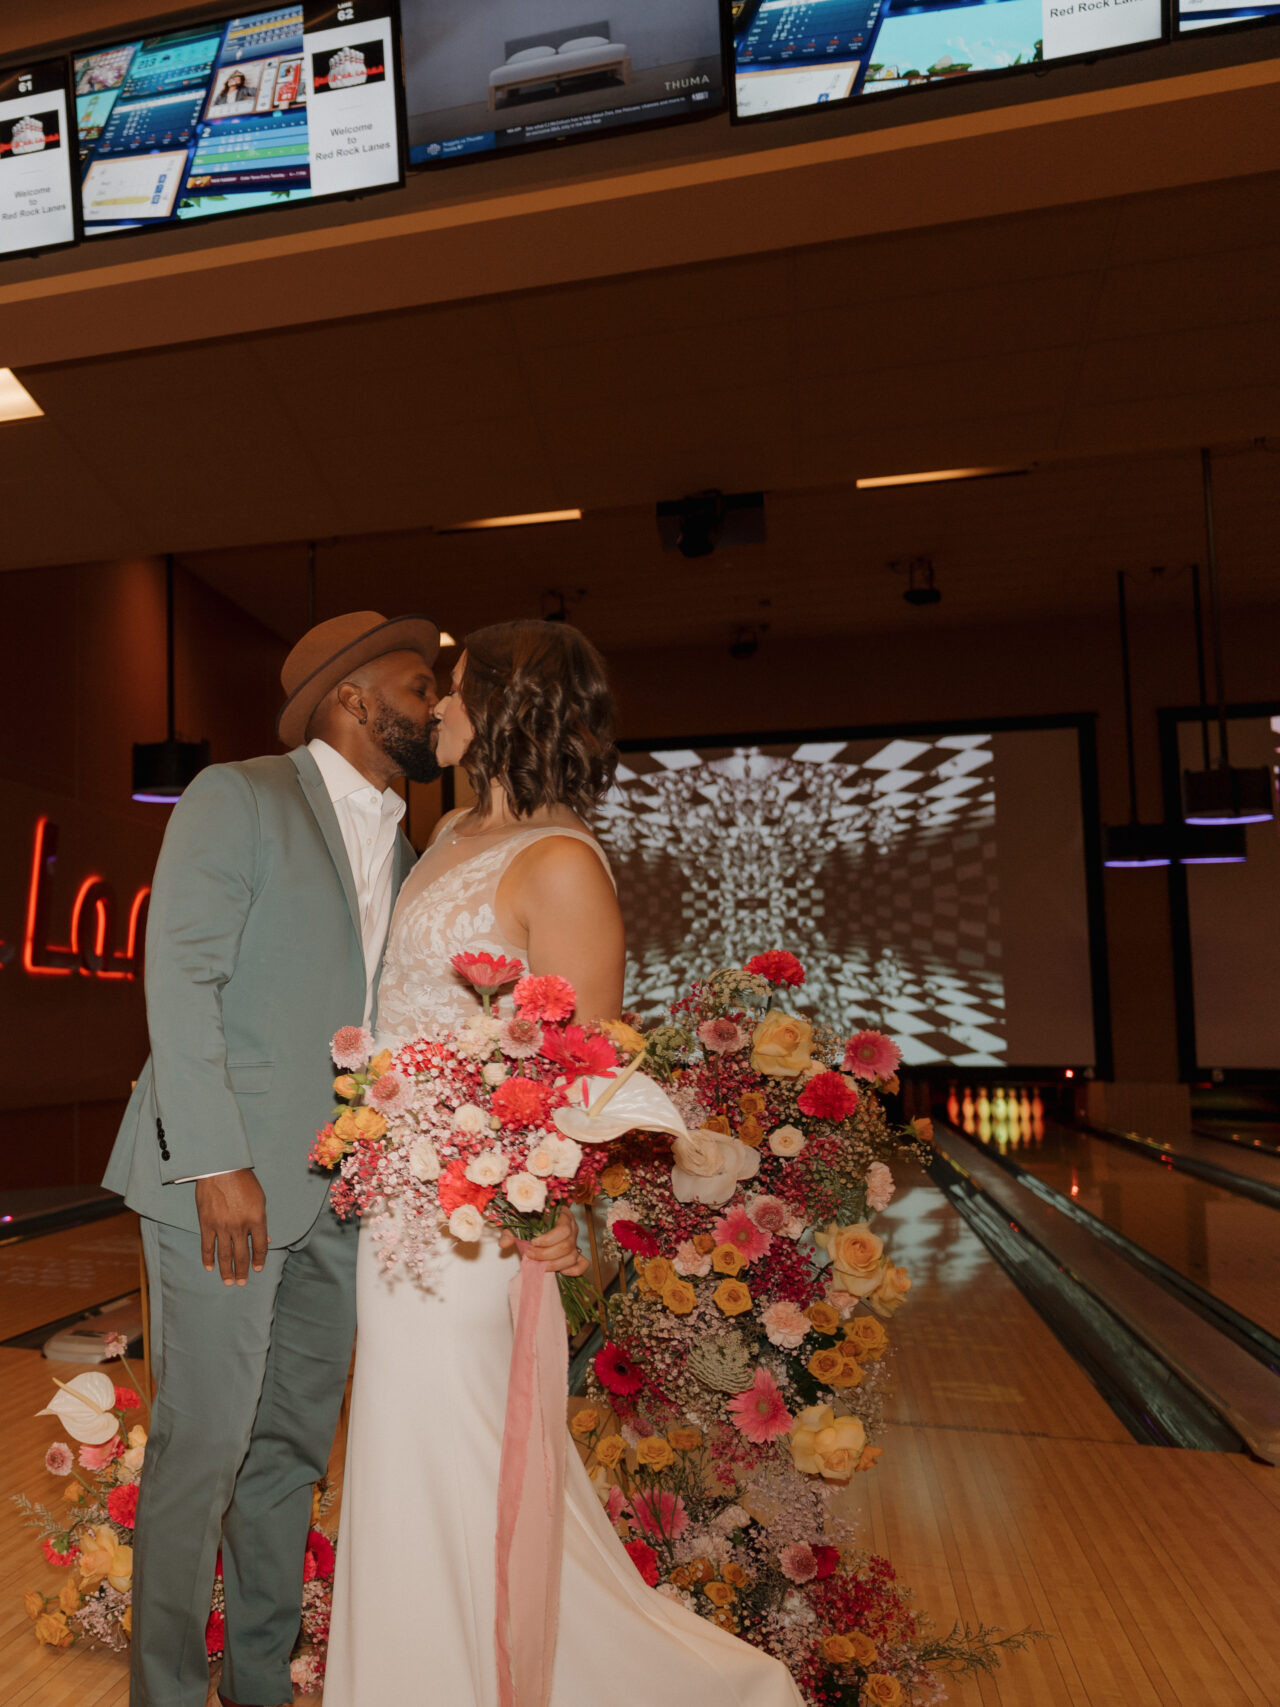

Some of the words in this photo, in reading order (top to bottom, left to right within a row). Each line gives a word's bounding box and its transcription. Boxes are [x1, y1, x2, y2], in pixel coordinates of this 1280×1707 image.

[337, 8, 355, 22] 62
[1050, 5, 1073, 18] Red
[18, 80, 33, 92] 61
[664, 74, 710, 91] THUMA
[330, 122, 373, 137] Welcome
[347, 136, 357, 144] to
[315, 151, 334, 161] Red
[336, 147, 359, 158] Rock
[362, 141, 391, 153] Lanes
[14, 186, 51, 199] Welcome
[28, 198, 38, 206] to
[1, 211, 18, 221] Red
[19, 207, 40, 218] Rock
[42, 203, 67, 214] Lanes
